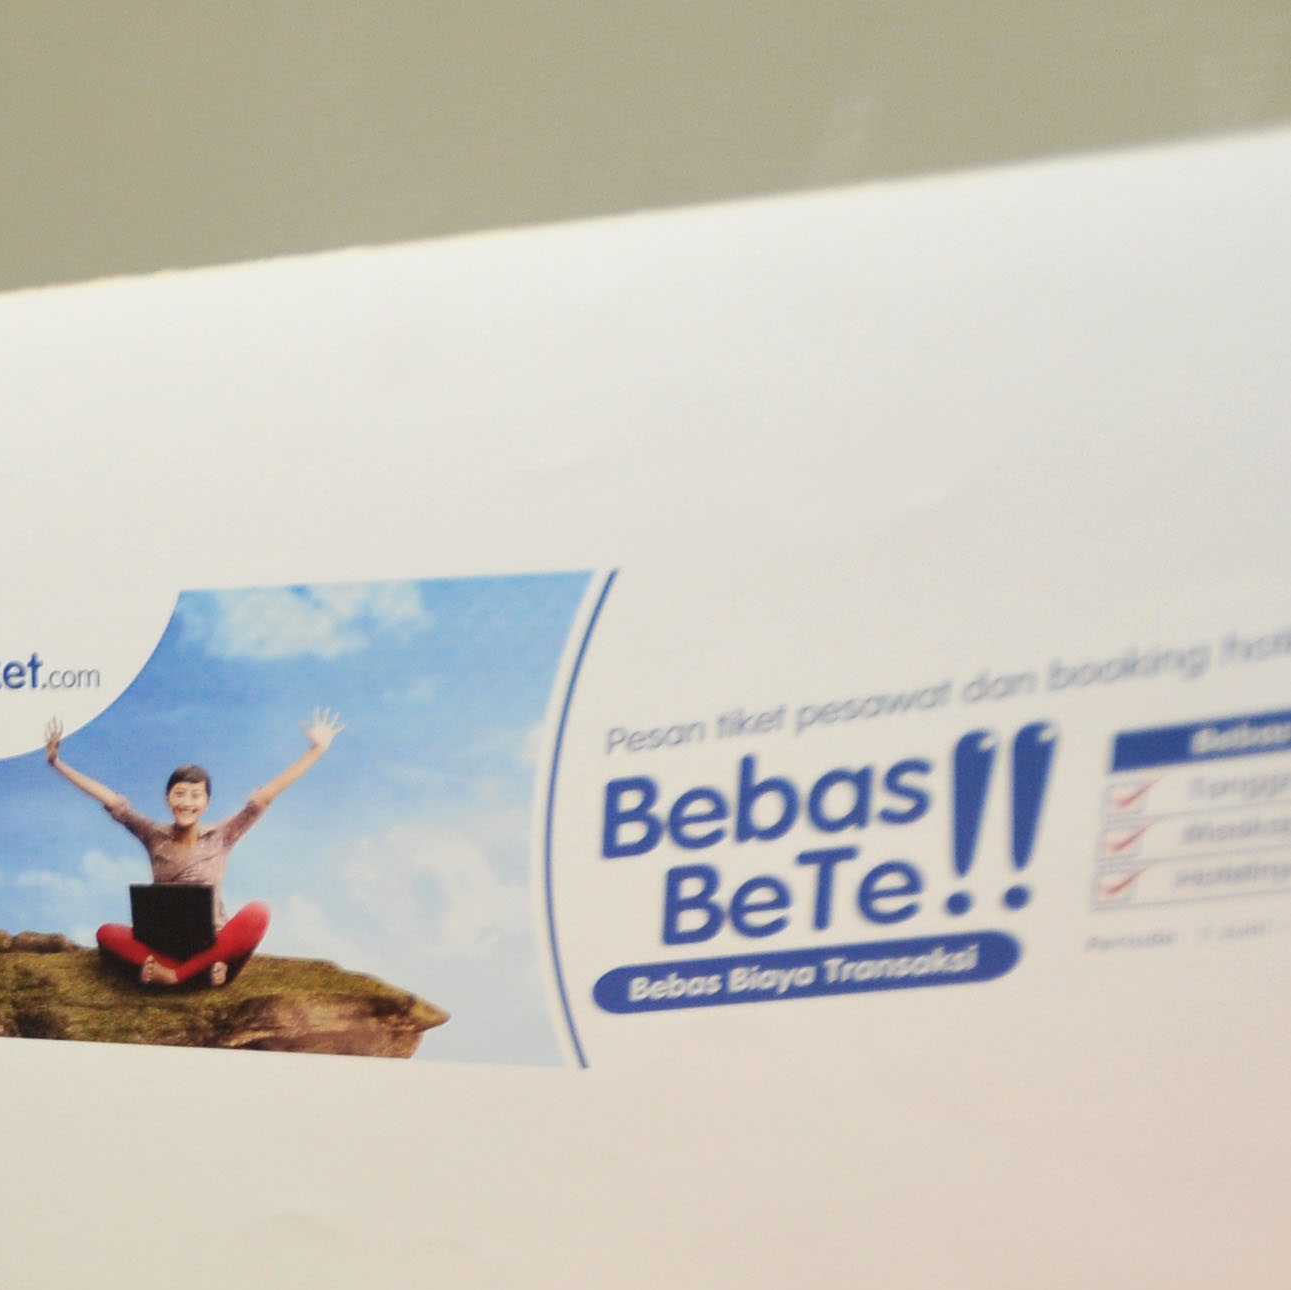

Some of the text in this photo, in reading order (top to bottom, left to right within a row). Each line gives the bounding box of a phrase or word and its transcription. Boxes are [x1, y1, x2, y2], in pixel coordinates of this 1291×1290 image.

[606, 720, 706, 754] Pesan
[717, 704, 787, 740] tiket
[794, 680, 952, 737] pesawat
[963, 666, 1039, 703] dan
[1046, 643, 1213, 684] booking
[601, 754, 936, 860] Bebas
[660, 843, 927, 946] BeTe
[626, 943, 981, 1003] Bebas Biaya Transaksi
